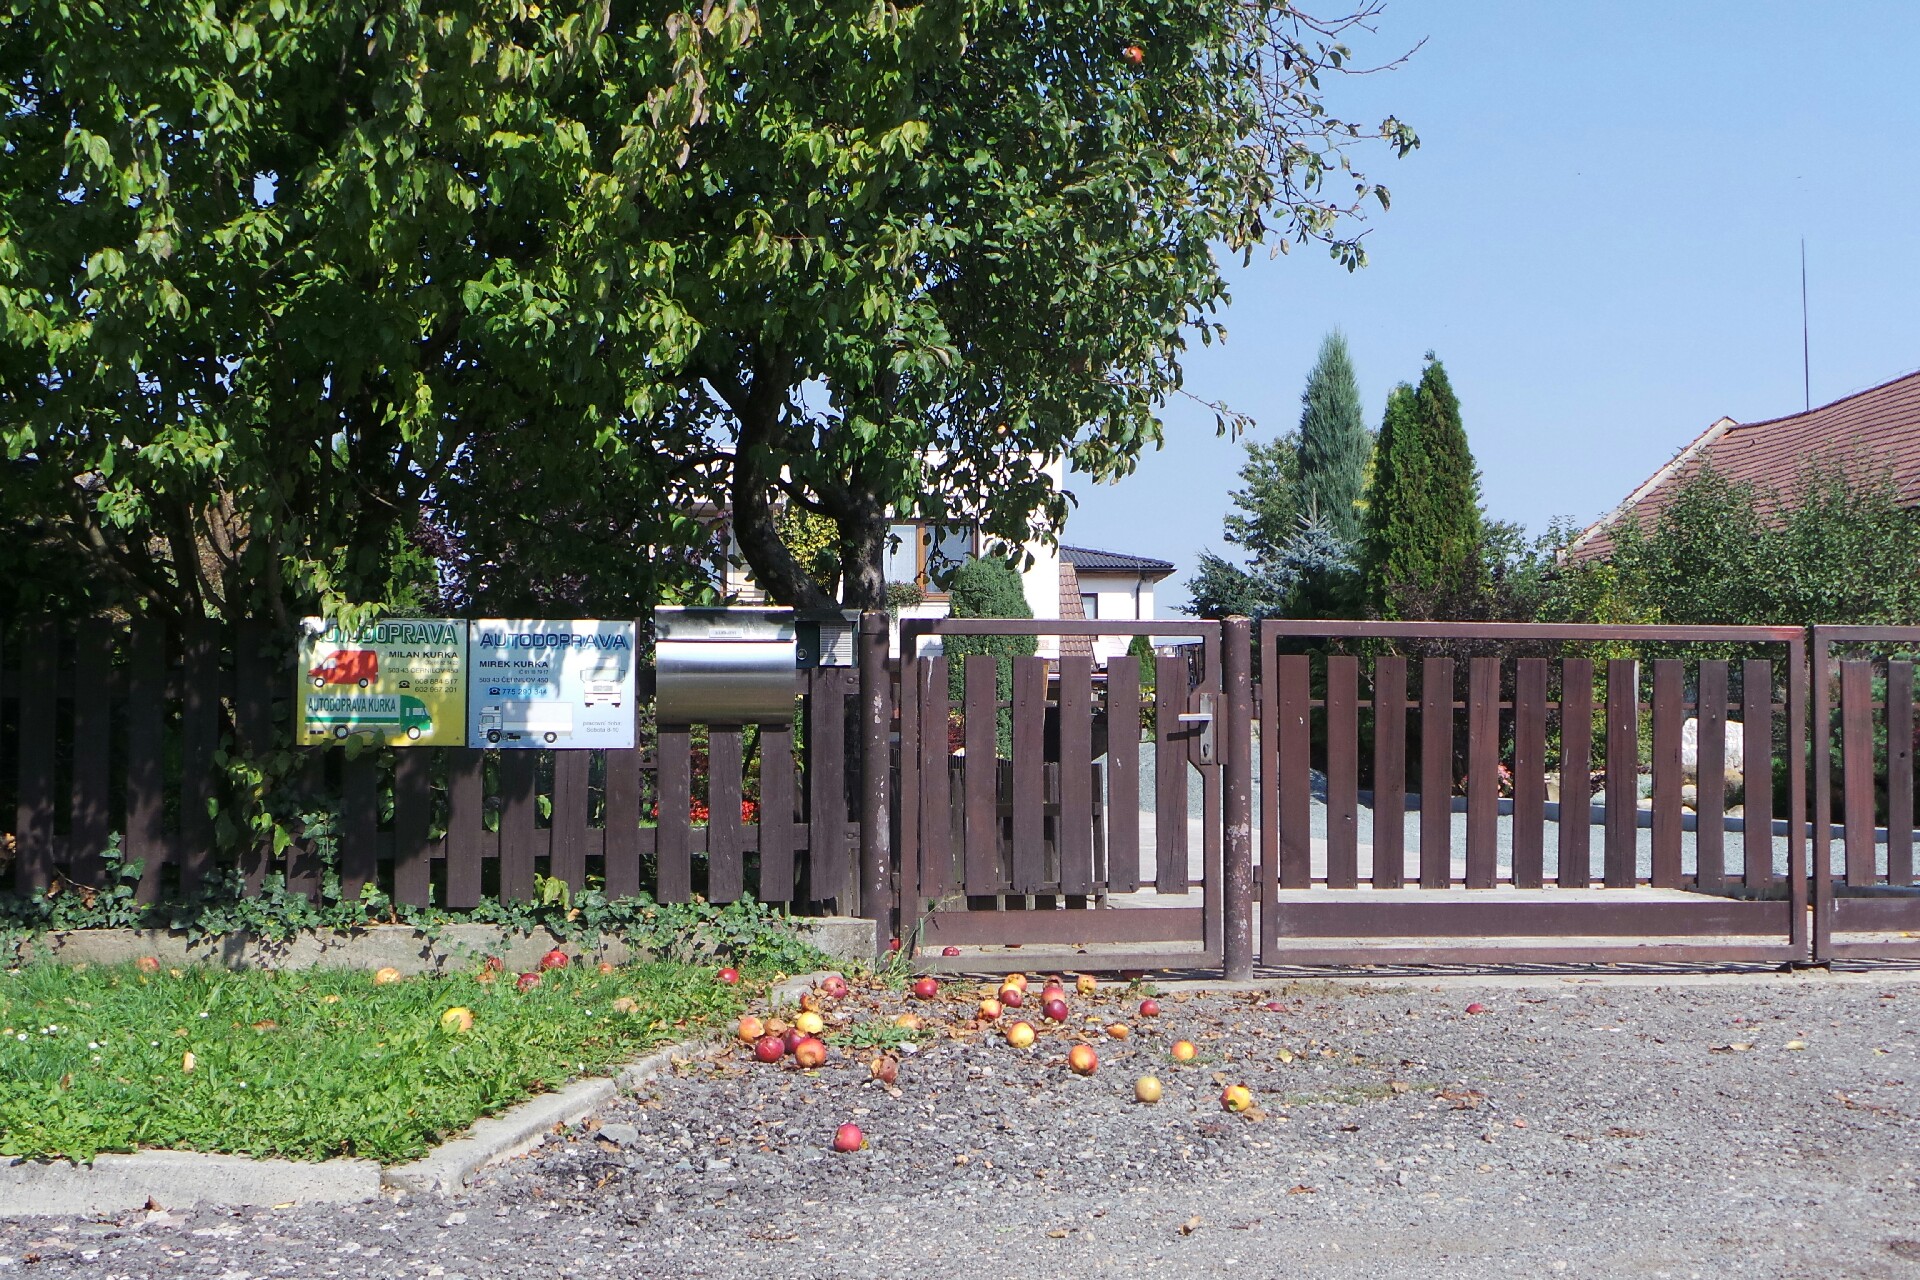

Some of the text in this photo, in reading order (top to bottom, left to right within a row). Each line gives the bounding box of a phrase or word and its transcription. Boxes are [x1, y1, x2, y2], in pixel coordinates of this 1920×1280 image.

[480, 633, 629, 650] AUTODOPRAVA
[388, 651, 458, 659] MILAN KURKA
[479, 660, 549, 668] MIREK KURKA
[308, 697, 396, 713] AUTODOPRAVA KURKA
